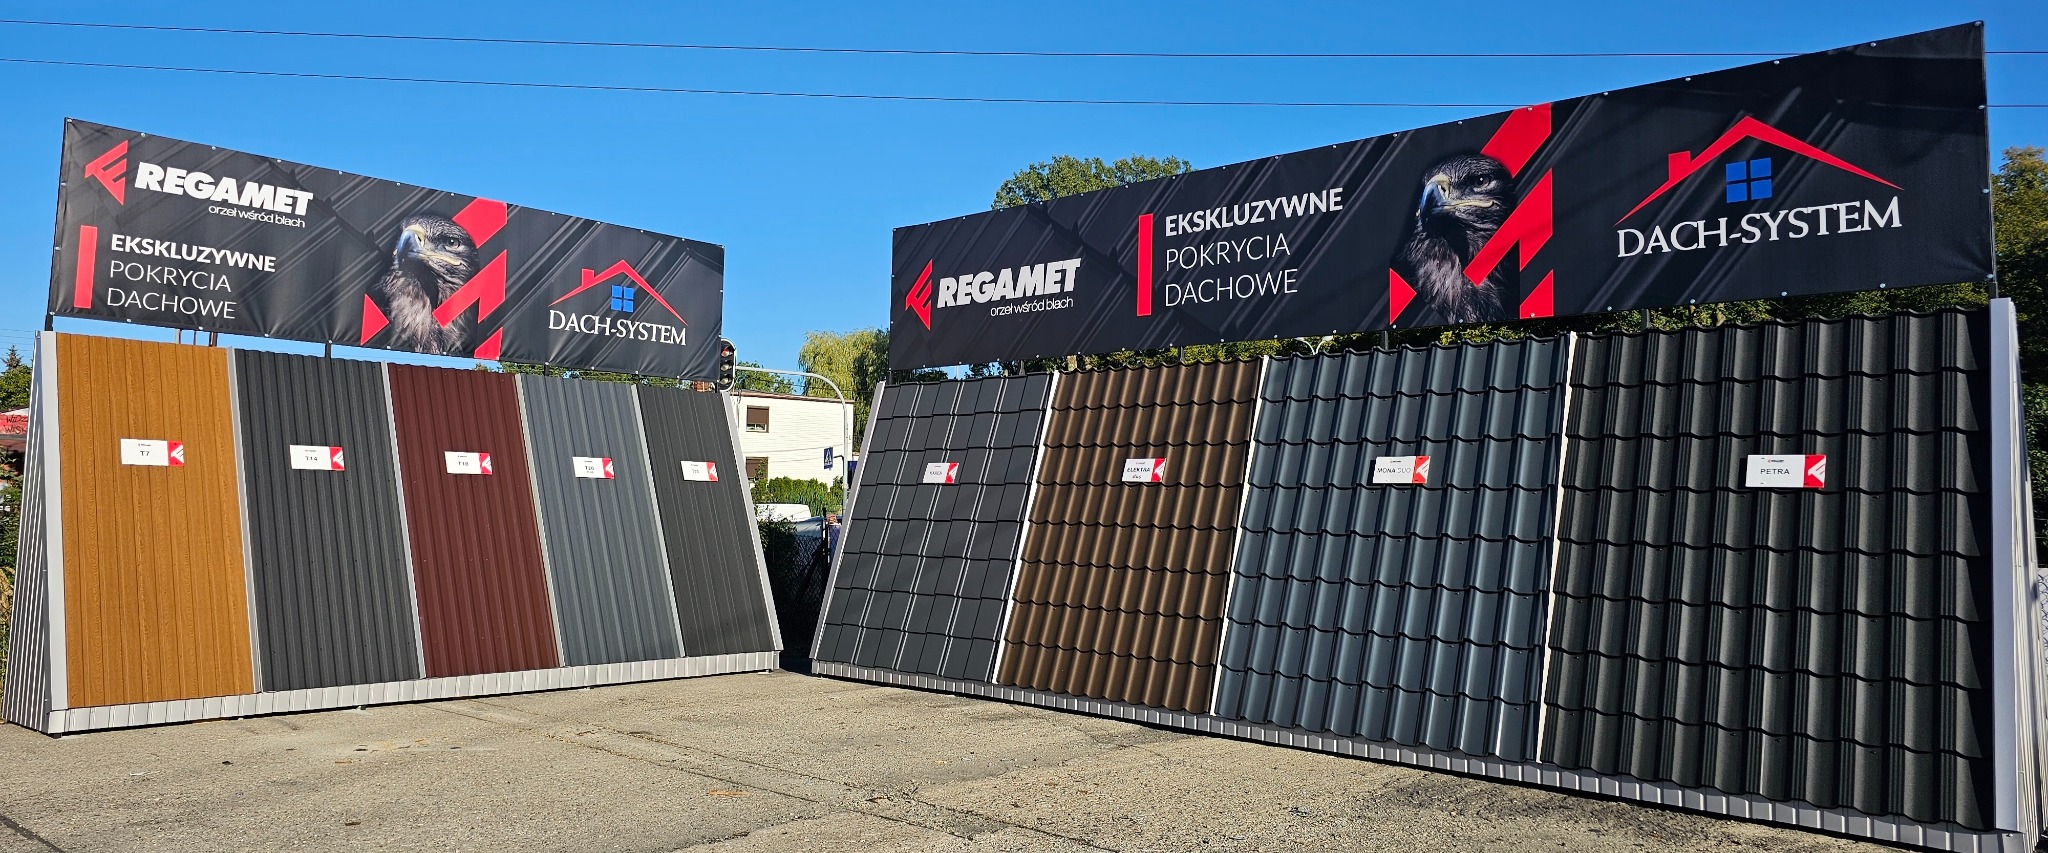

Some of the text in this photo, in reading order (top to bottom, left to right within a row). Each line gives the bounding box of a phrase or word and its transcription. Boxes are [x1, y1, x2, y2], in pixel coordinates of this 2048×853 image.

[135, 162, 314, 216] REGAMET
[208, 205, 305, 228] orzeł wśród blach
[1165, 187, 1343, 237] EKSKLUZYWNE
[1617, 196, 1902, 258] DACH-SYSTEM
[111, 234, 277, 273] EKSKLUZYWNE
[1166, 232, 1290, 271] POKRYCIA
[109, 260, 232, 293] POKRYCIA
[937, 258, 1081, 308] REGAMET
[1165, 268, 1298, 307] DACHOWE
[107, 287, 237, 319] DACHOWE
[990, 296, 1074, 317] orzeł wśród blach
[548, 310, 687, 346] DACH-SYSTEM
